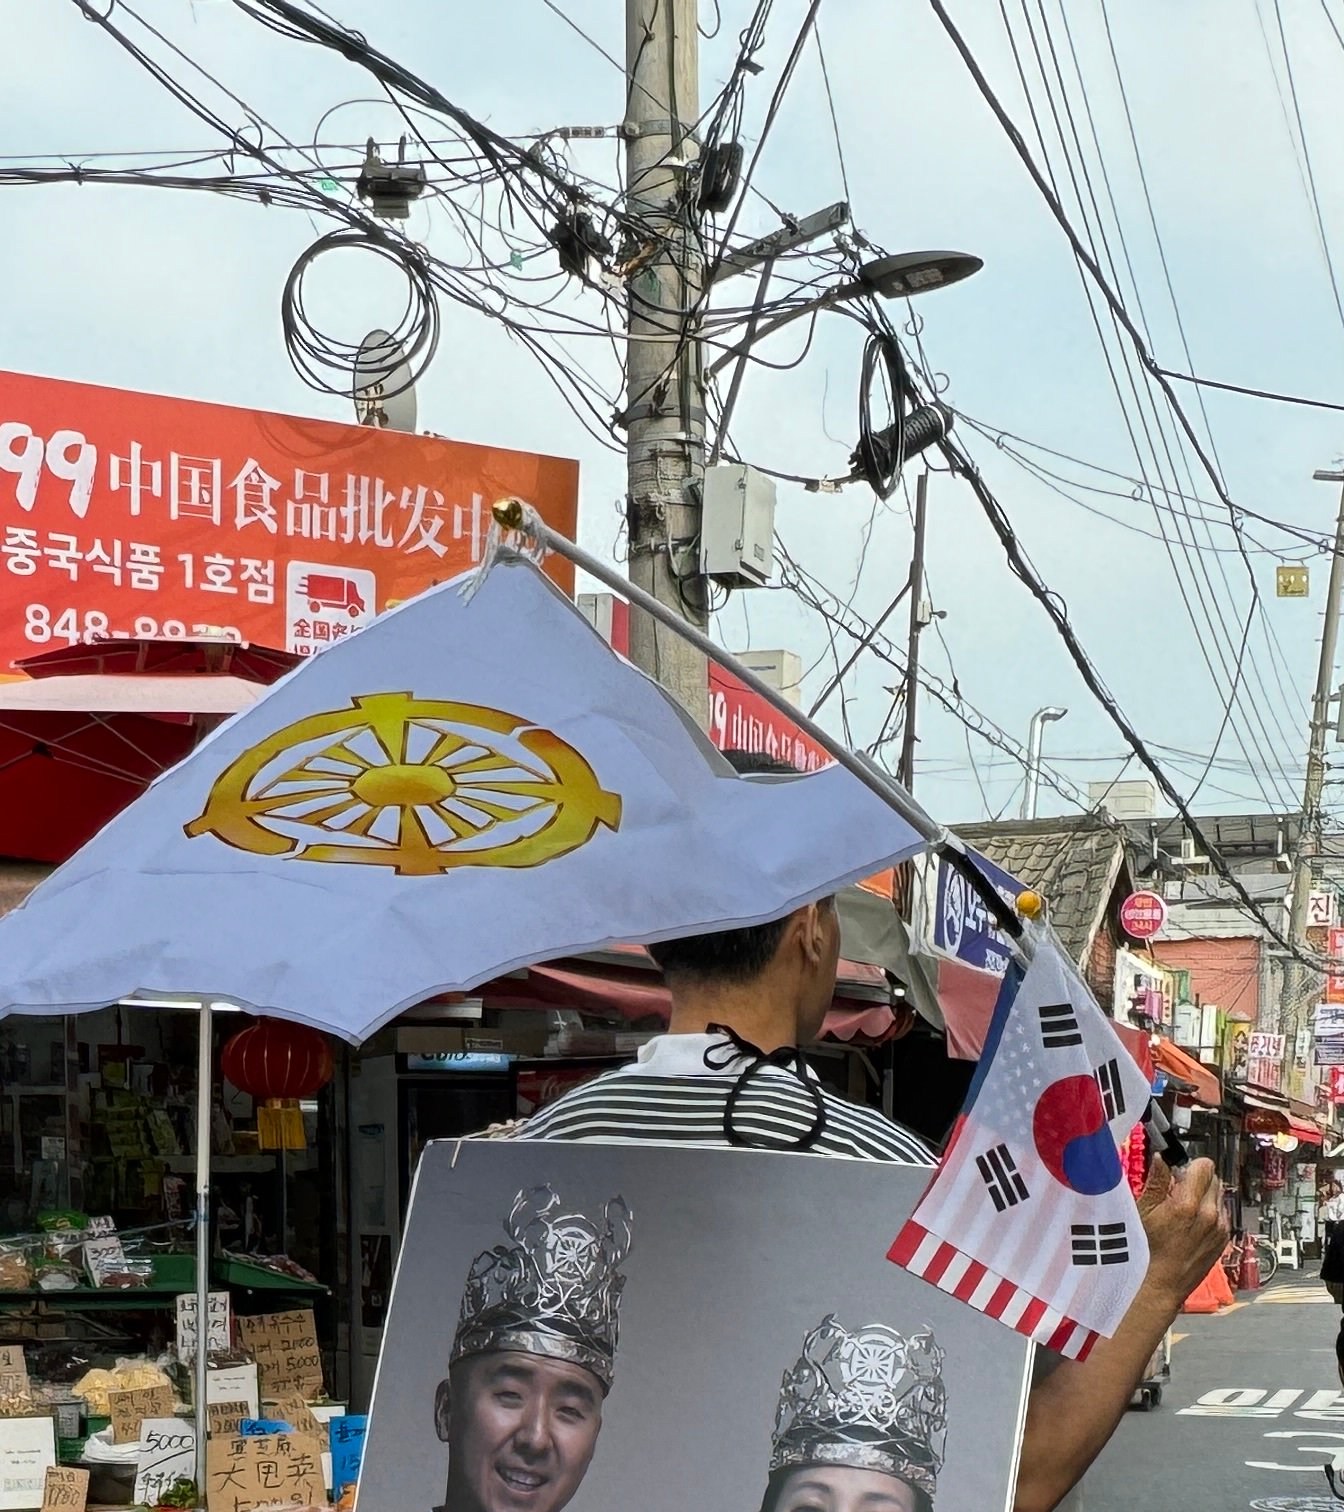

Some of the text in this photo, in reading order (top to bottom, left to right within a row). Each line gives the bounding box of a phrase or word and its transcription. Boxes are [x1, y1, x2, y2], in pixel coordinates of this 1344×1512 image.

[177, 552, 276, 605] 1호점
[146, 1430, 194, 1450] 5000
[212, 1453, 320, 1493] 大甩卖
